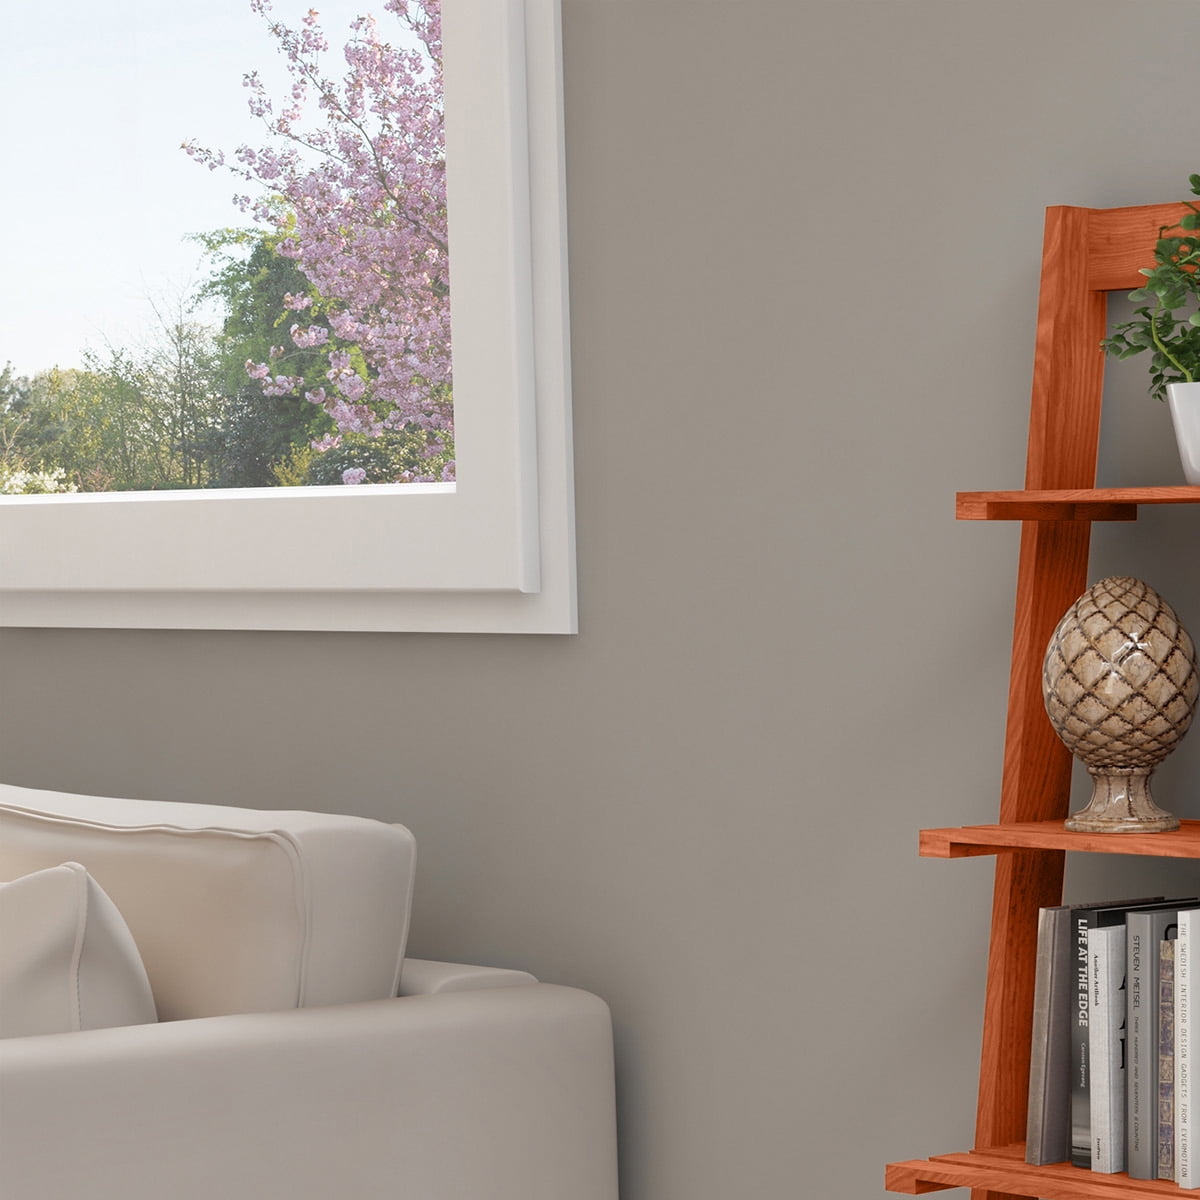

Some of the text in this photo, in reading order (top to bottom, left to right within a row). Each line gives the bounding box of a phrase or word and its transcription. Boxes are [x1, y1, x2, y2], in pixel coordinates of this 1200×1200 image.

[1078, 919, 1089, 1027] LIFE AT THE EDGE
[1180, 1028, 1188, 1059] DESIGN
